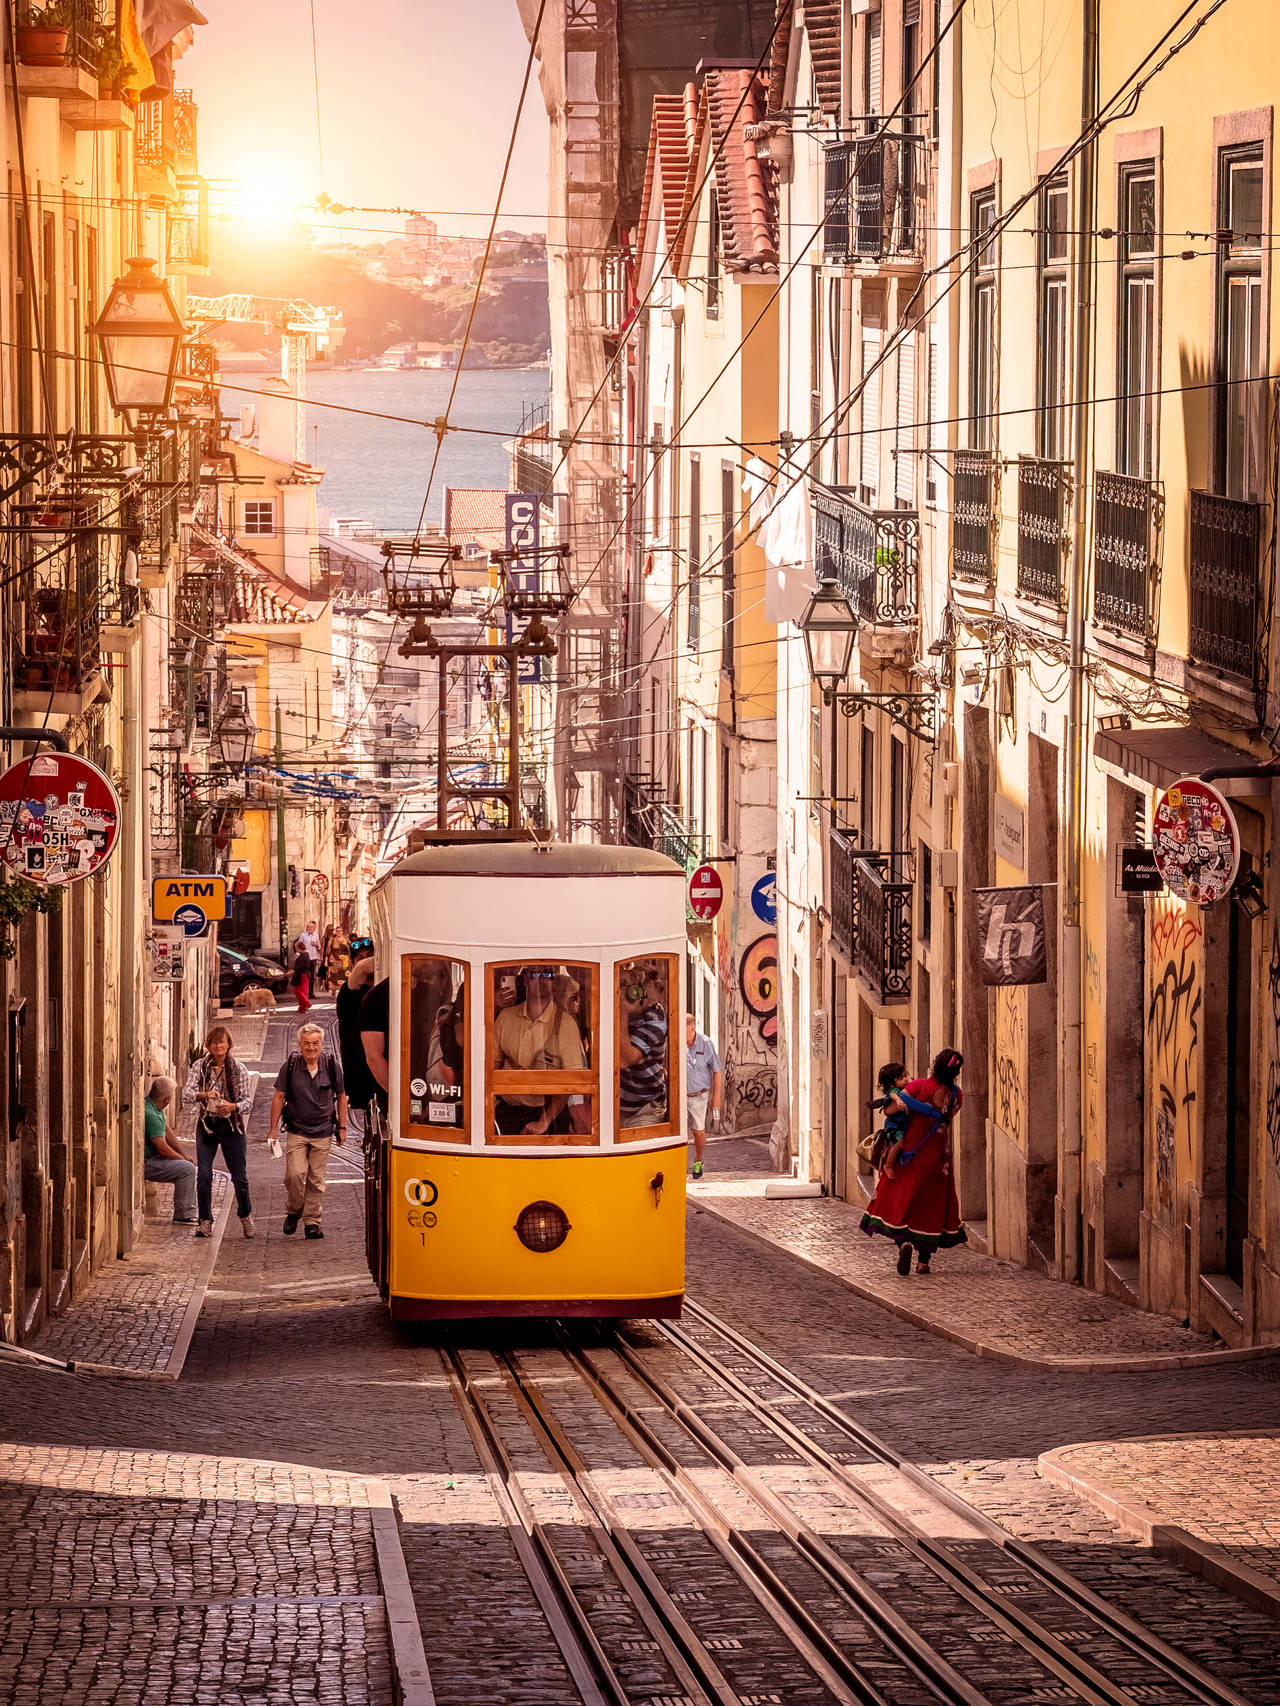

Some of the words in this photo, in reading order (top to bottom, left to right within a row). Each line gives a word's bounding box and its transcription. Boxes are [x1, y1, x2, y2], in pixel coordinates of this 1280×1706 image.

[165, 883, 214, 897] ATM
[429, 1083, 462, 1097] WI-FI
[420, 1232, 425, 1247] 1
